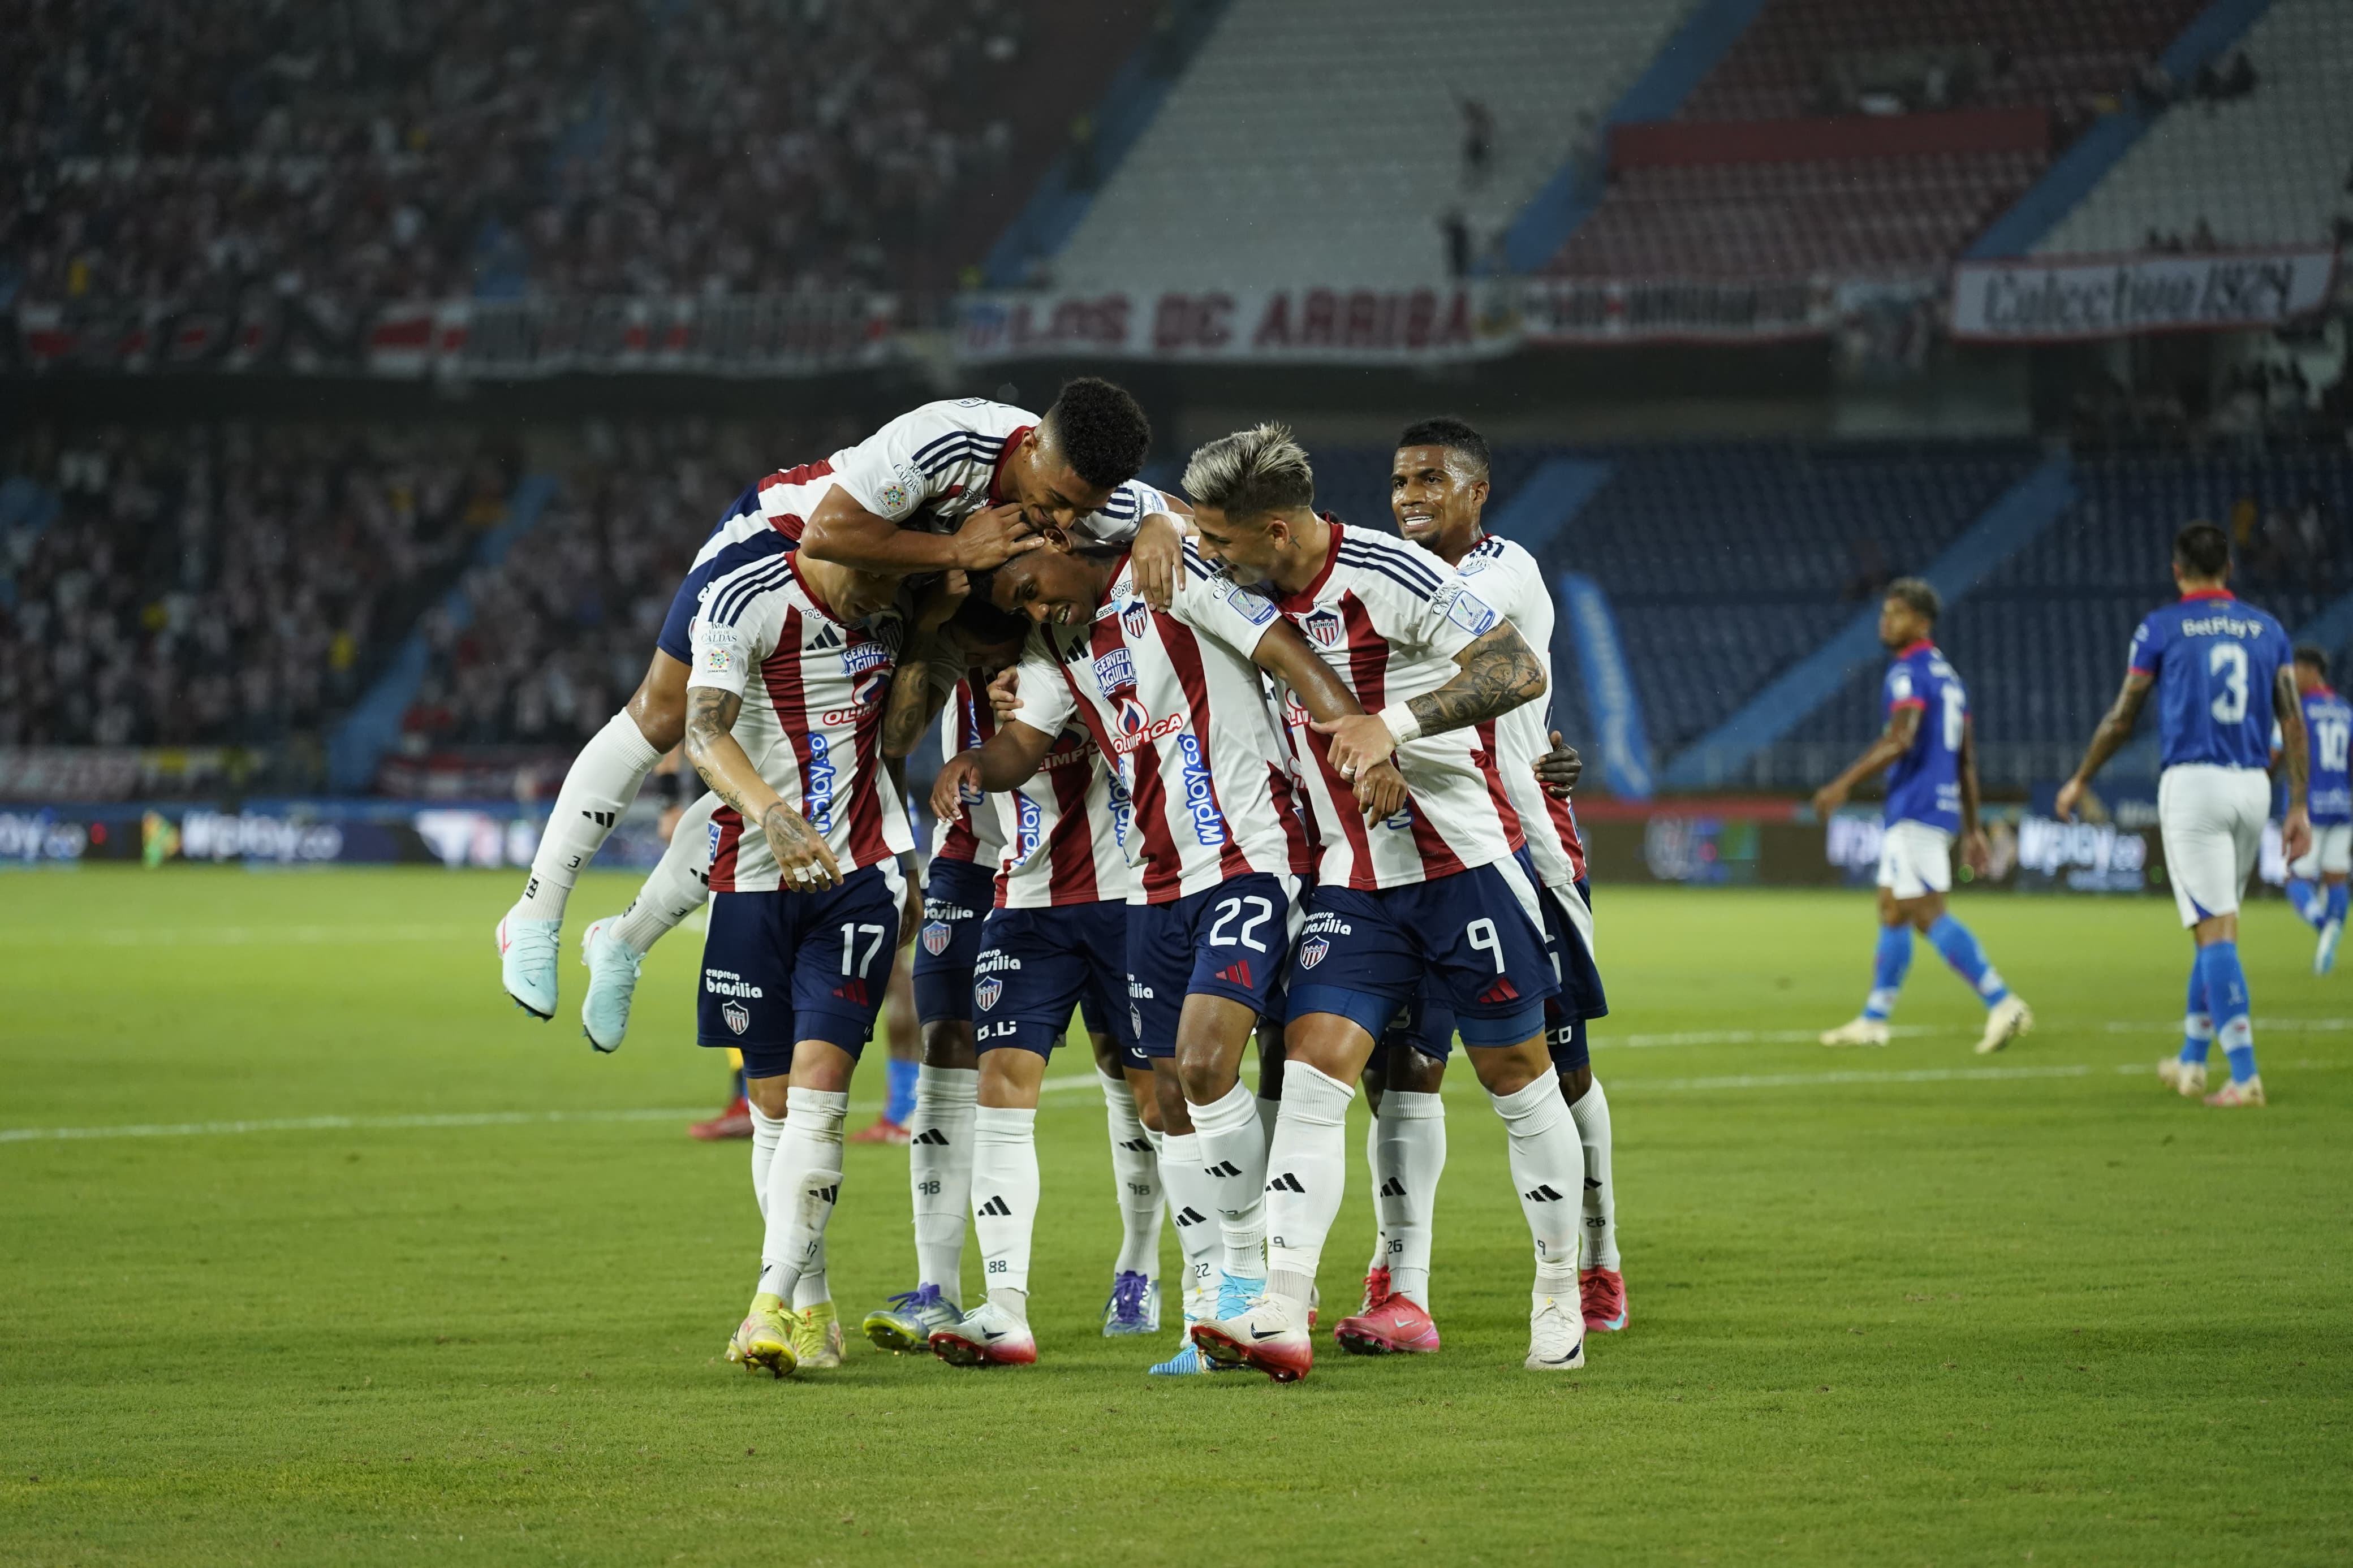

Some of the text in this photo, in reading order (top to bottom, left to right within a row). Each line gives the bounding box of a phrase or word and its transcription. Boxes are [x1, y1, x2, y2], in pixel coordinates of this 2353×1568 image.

[1100, 663, 1134, 692] AGUILA
[2210, 642, 2248, 724] 3
[1114, 714, 1182, 754] OLIMPICA
[2315, 722, 2350, 772] 10
[567, 855, 581, 869] 3
[1209, 895, 1273, 953] 22
[841, 923, 885, 979] 17
[1467, 917, 1506, 974] 9
[706, 969, 740, 982] expreso
[706, 978, 763, 999] brasilia
[918, 1181, 941, 1195] 98
[1127, 1182, 1150, 1196] 98
[1586, 1216, 1606, 1228] 26
[807, 1241, 817, 1258] 17
[1273, 1236, 1285, 1247] 9
[1387, 1239, 1403, 1254] 26
[1537, 1239, 1546, 1255] 9
[989, 1260, 1007, 1273] 88
[1195, 1263, 1212, 1279] 22
